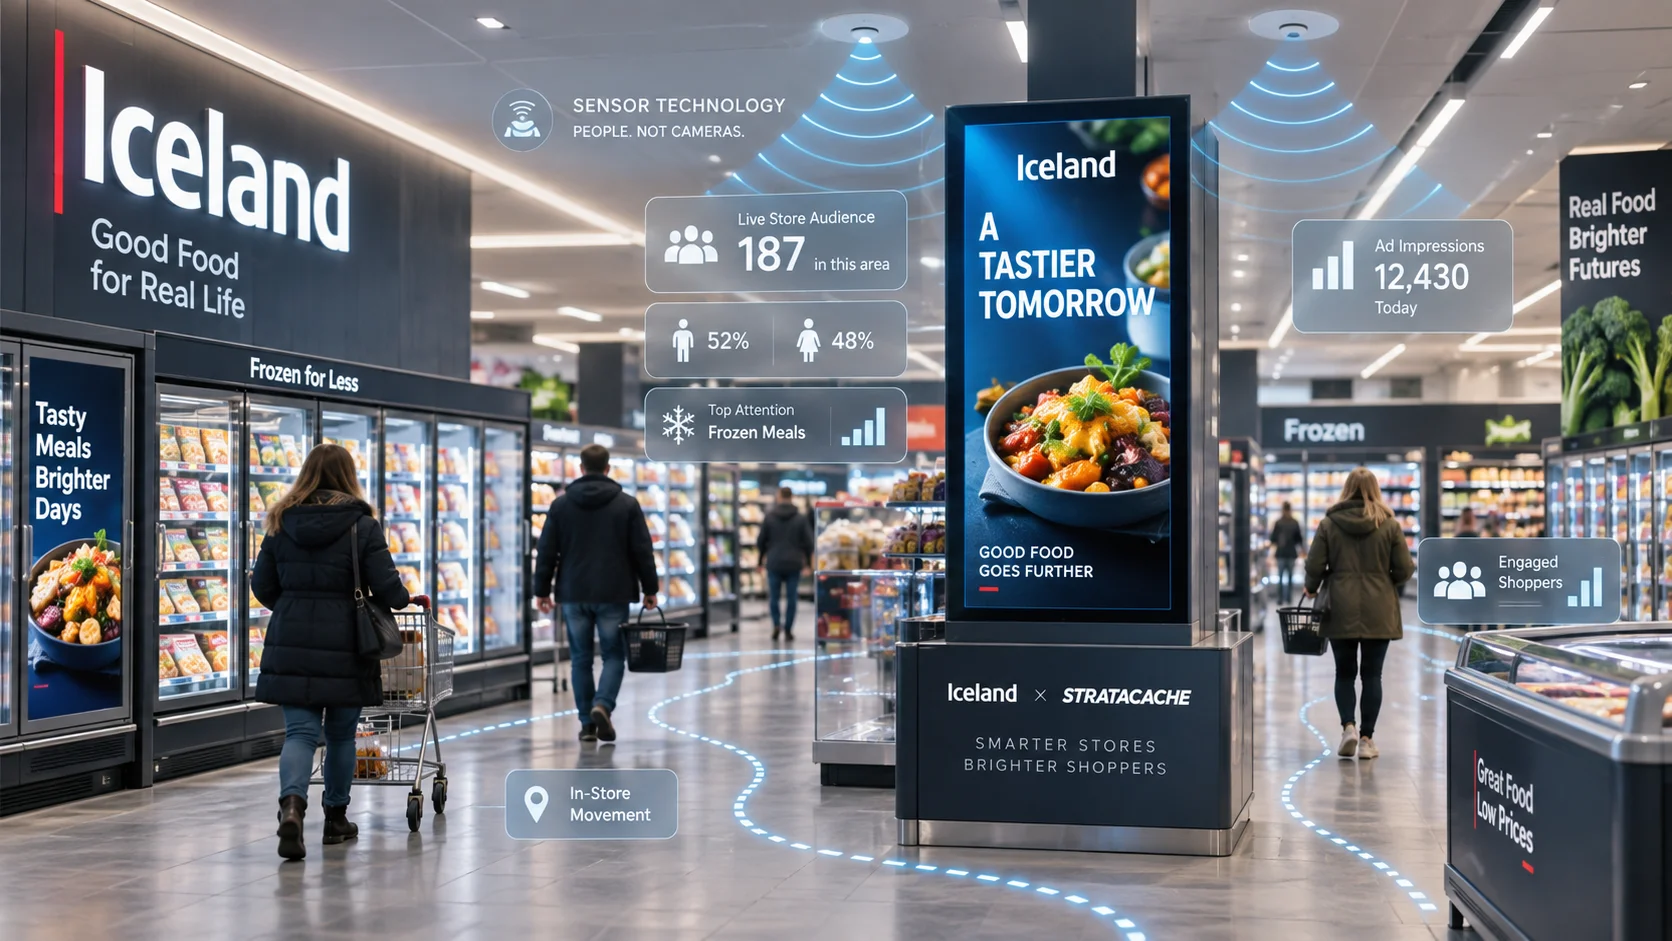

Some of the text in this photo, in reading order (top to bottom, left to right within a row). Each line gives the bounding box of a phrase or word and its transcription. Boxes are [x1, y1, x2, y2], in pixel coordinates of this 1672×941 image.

[85, 64, 350, 253] Iceland
[1018, 150, 1115, 181] Iceland
[1570, 188, 1655, 218] Real Food
[979, 212, 999, 241] A
[1570, 223, 1647, 253] Brighter
[91, 218, 238, 280] Good Food
[979, 249, 1095, 279] TASTIER
[1570, 258, 1640, 281] Futures
[91, 259, 245, 318] for Real Life
[979, 287, 1155, 319] TOMORROW
[251, 357, 358, 392] Frozen for Less
[36, 401, 86, 432] Tasty
[1285, 419, 1364, 441] Frozen
[36, 434, 91, 458] Meals
[36, 466, 110, 495] Brighter
[36, 497, 81, 525] Days
[980, 546, 1073, 558] GOOD FOOD
[979, 565, 1093, 577] GOES FURTHER
[949, 683, 1017, 702] Iceland
[1062, 688, 1191, 705] STRATACACHE
[976, 737, 1155, 753] SMARTER STORES
[965, 759, 1166, 775] BRIGHTER SHOPPERS
[1478, 758, 1533, 814] Great Food
[1478, 792, 1533, 853] Low Prices
